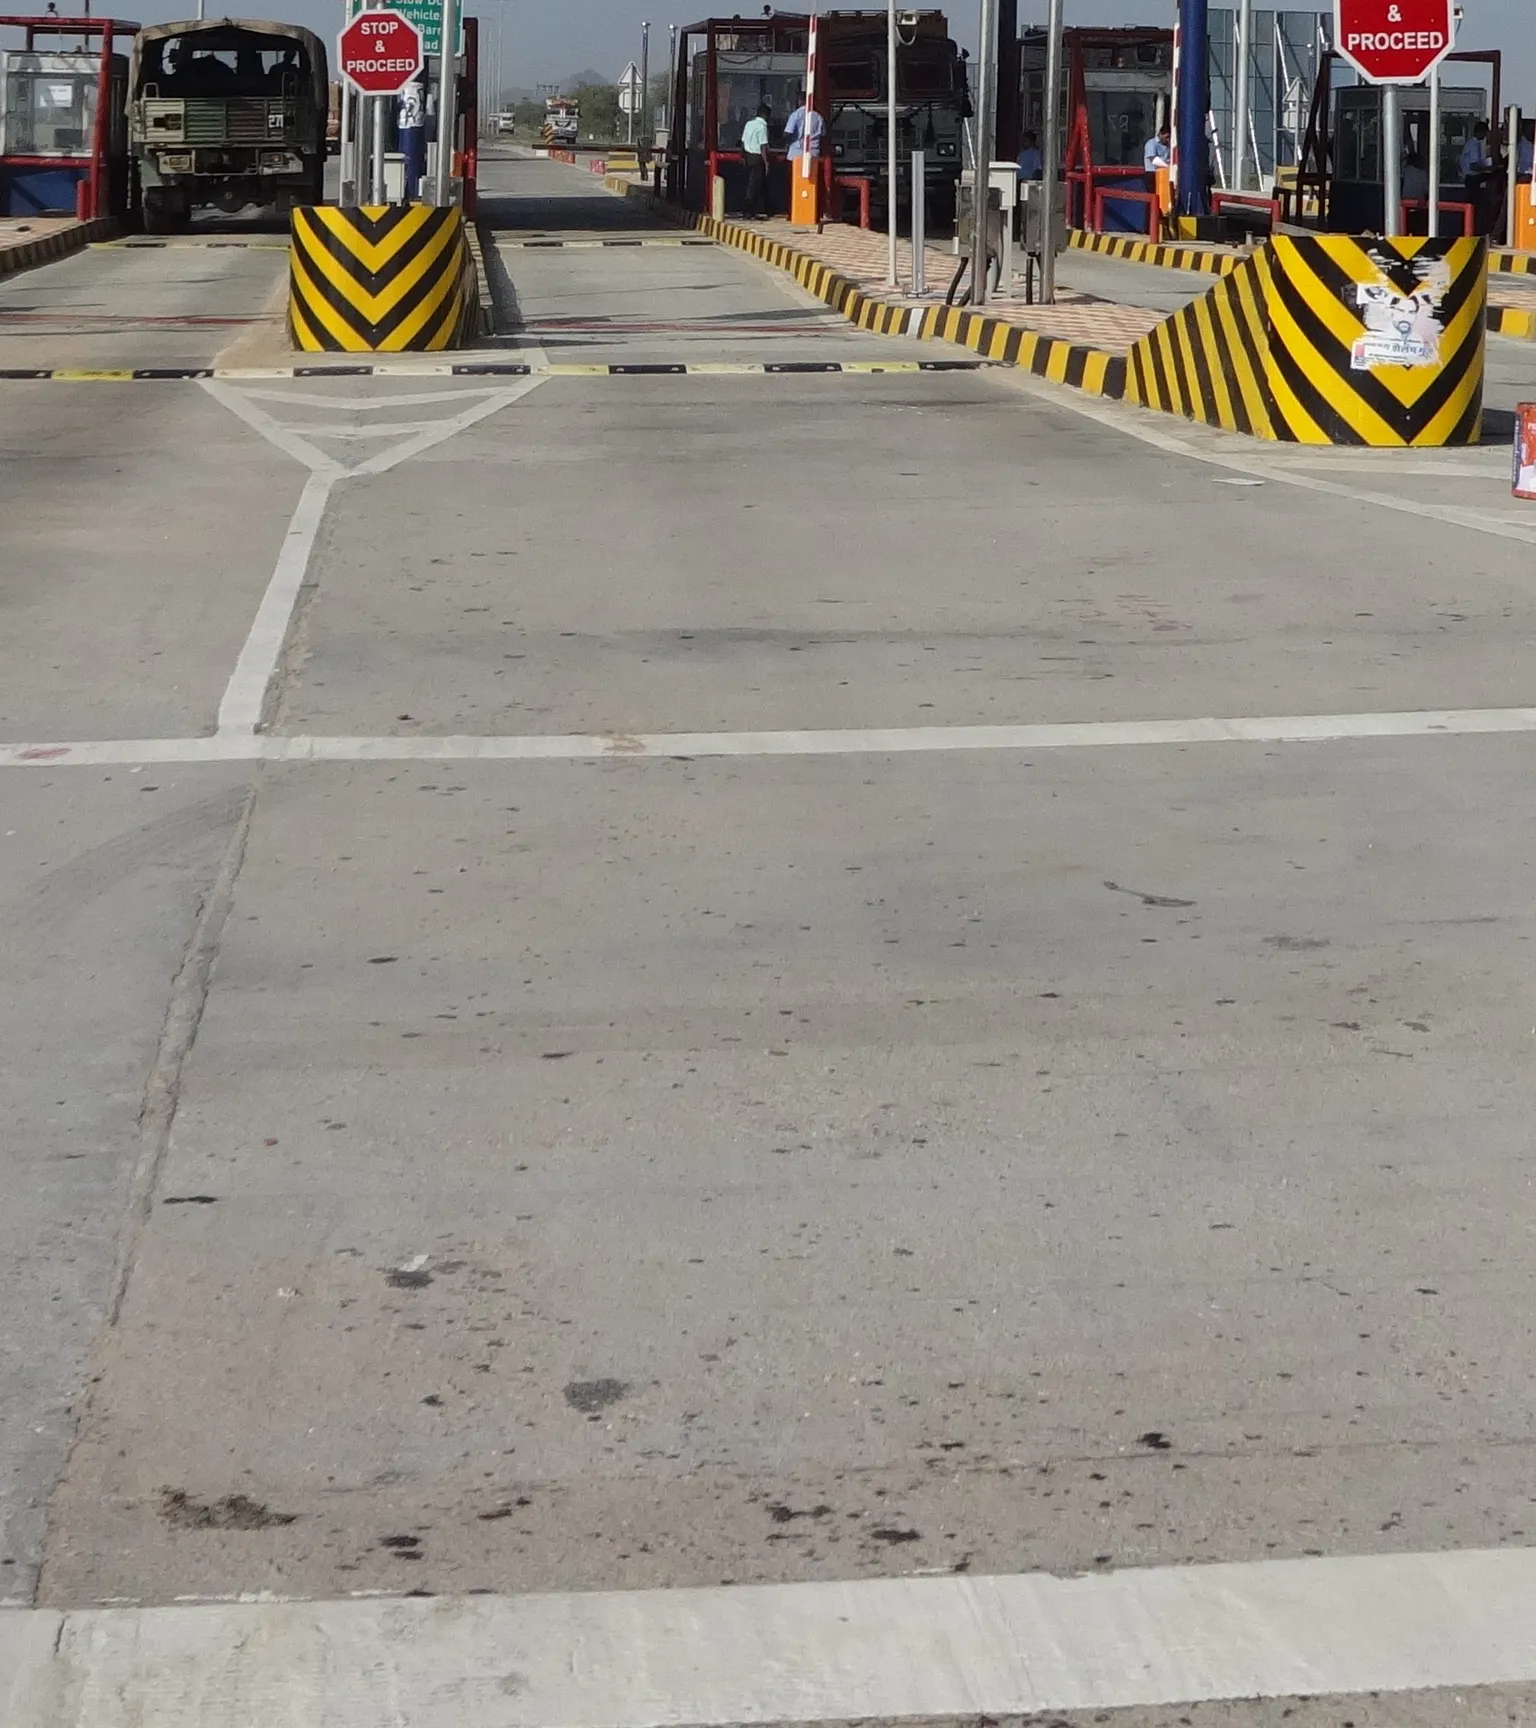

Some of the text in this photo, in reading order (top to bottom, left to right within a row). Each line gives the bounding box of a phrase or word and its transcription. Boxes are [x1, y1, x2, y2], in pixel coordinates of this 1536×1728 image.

[1387, 4, 1402, 22] &
[361, 21, 398, 35] STOP
[418, 24, 441, 34] Barr
[375, 40, 385, 53] &
[1347, 32, 1444, 51] PROCEED
[347, 59, 415, 73] PROCEED
